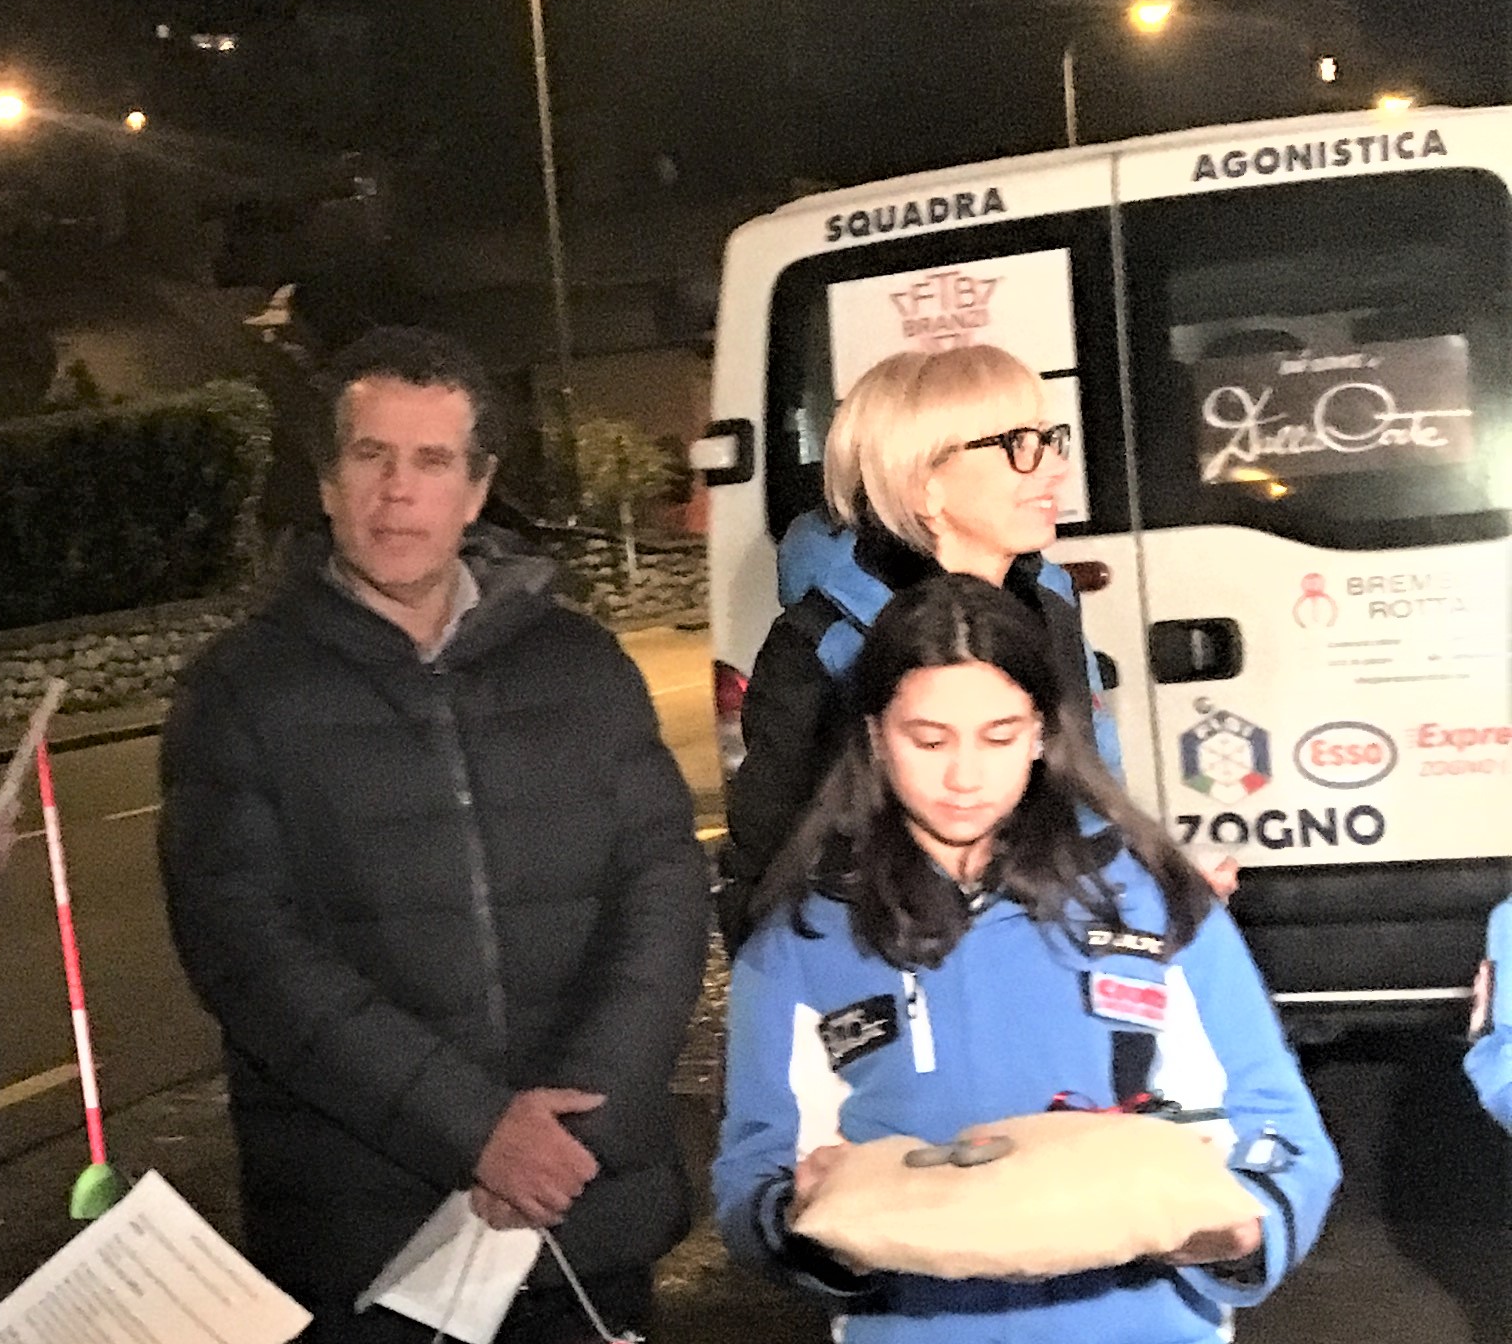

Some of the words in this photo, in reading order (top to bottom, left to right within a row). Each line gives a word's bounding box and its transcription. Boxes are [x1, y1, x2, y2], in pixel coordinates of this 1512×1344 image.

[824, 186, 1008, 242] SQUADRA
[1192, 129, 1449, 182] AGONISTICA
[1309, 739, 1383, 767] Esso
[1176, 804, 1386, 850] ZOGNO
